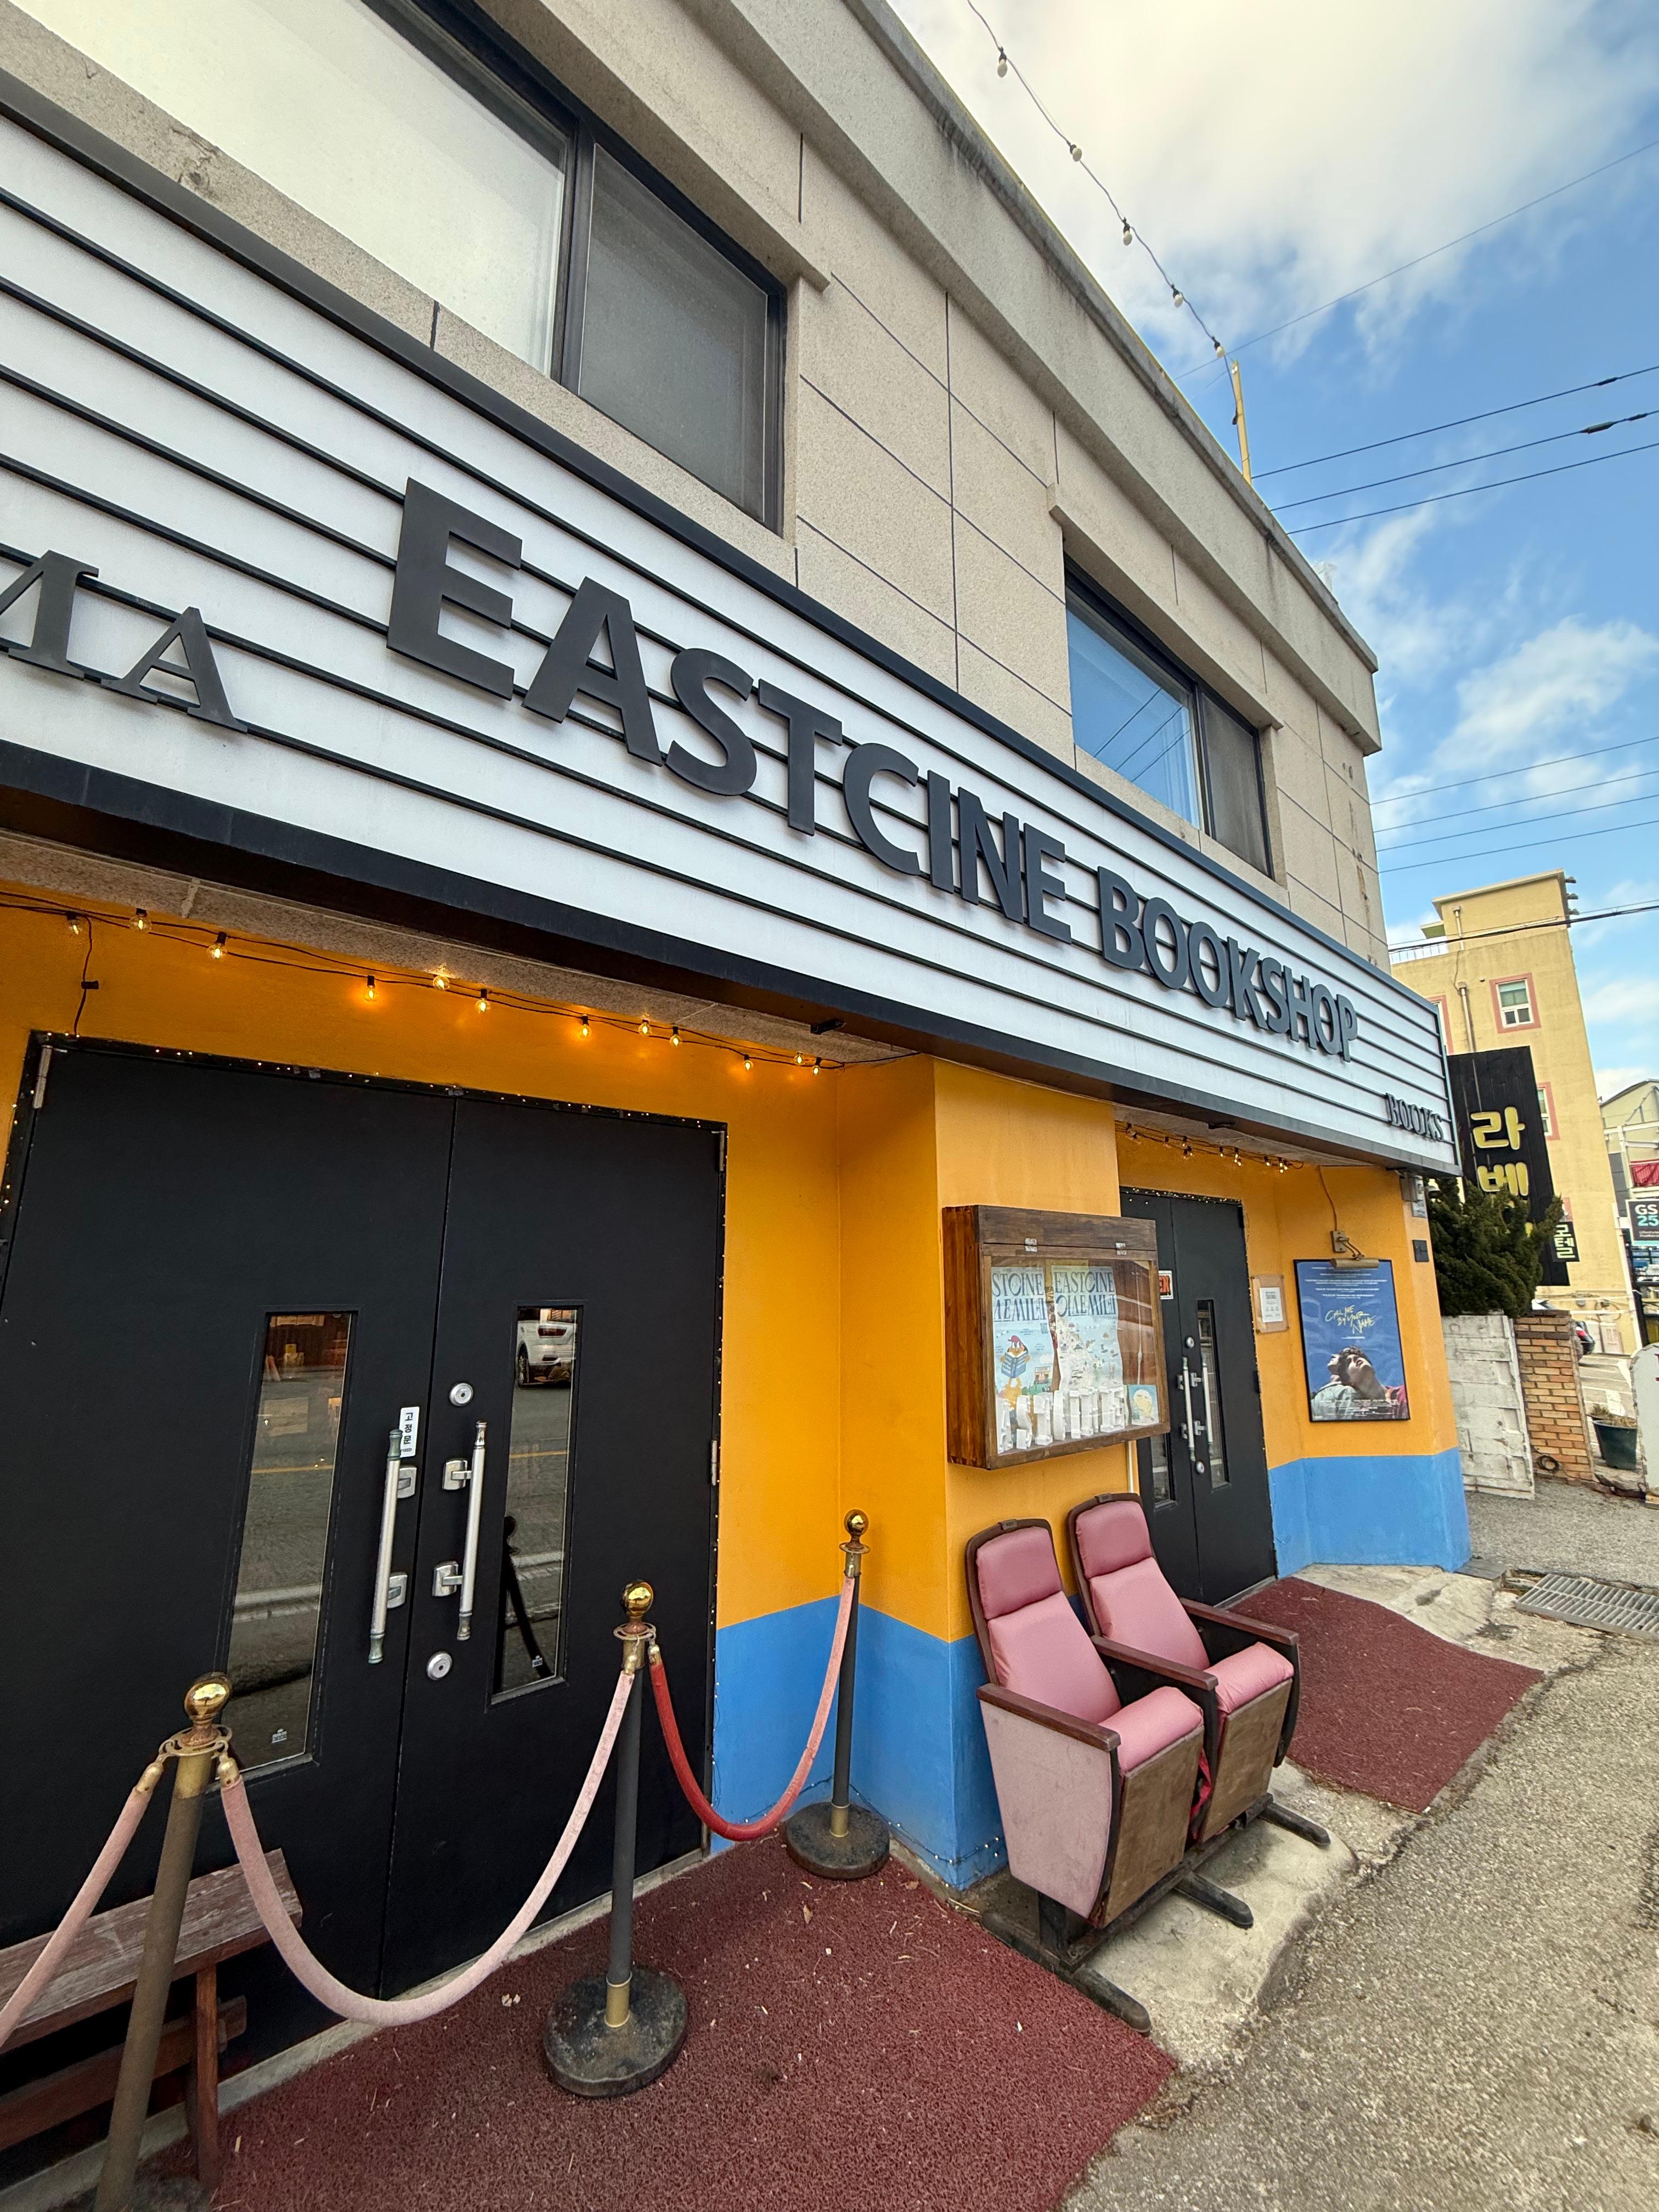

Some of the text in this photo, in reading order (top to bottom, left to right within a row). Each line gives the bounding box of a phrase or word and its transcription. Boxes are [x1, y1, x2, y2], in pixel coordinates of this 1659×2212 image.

[386, 477, 1358, 1063] EASTCINE BOOKSHOP
[1385, 1092, 1444, 1142] BOOKS
[1634, 1204, 1658, 1215] GS
[1637, 1215, 1659, 1227] 25
[992, 1273, 1045, 1297] STCINE
[1054, 1271, 1115, 1293] EASTCINE
[1158, 1275, 1170, 1293] EN
[1338, 1311, 1369, 1327] BY YOUR
[1344, 1305, 1355, 1318] ME
[1352, 1316, 1377, 1334] NAME
[403, 1412, 414, 1445] 고정문
